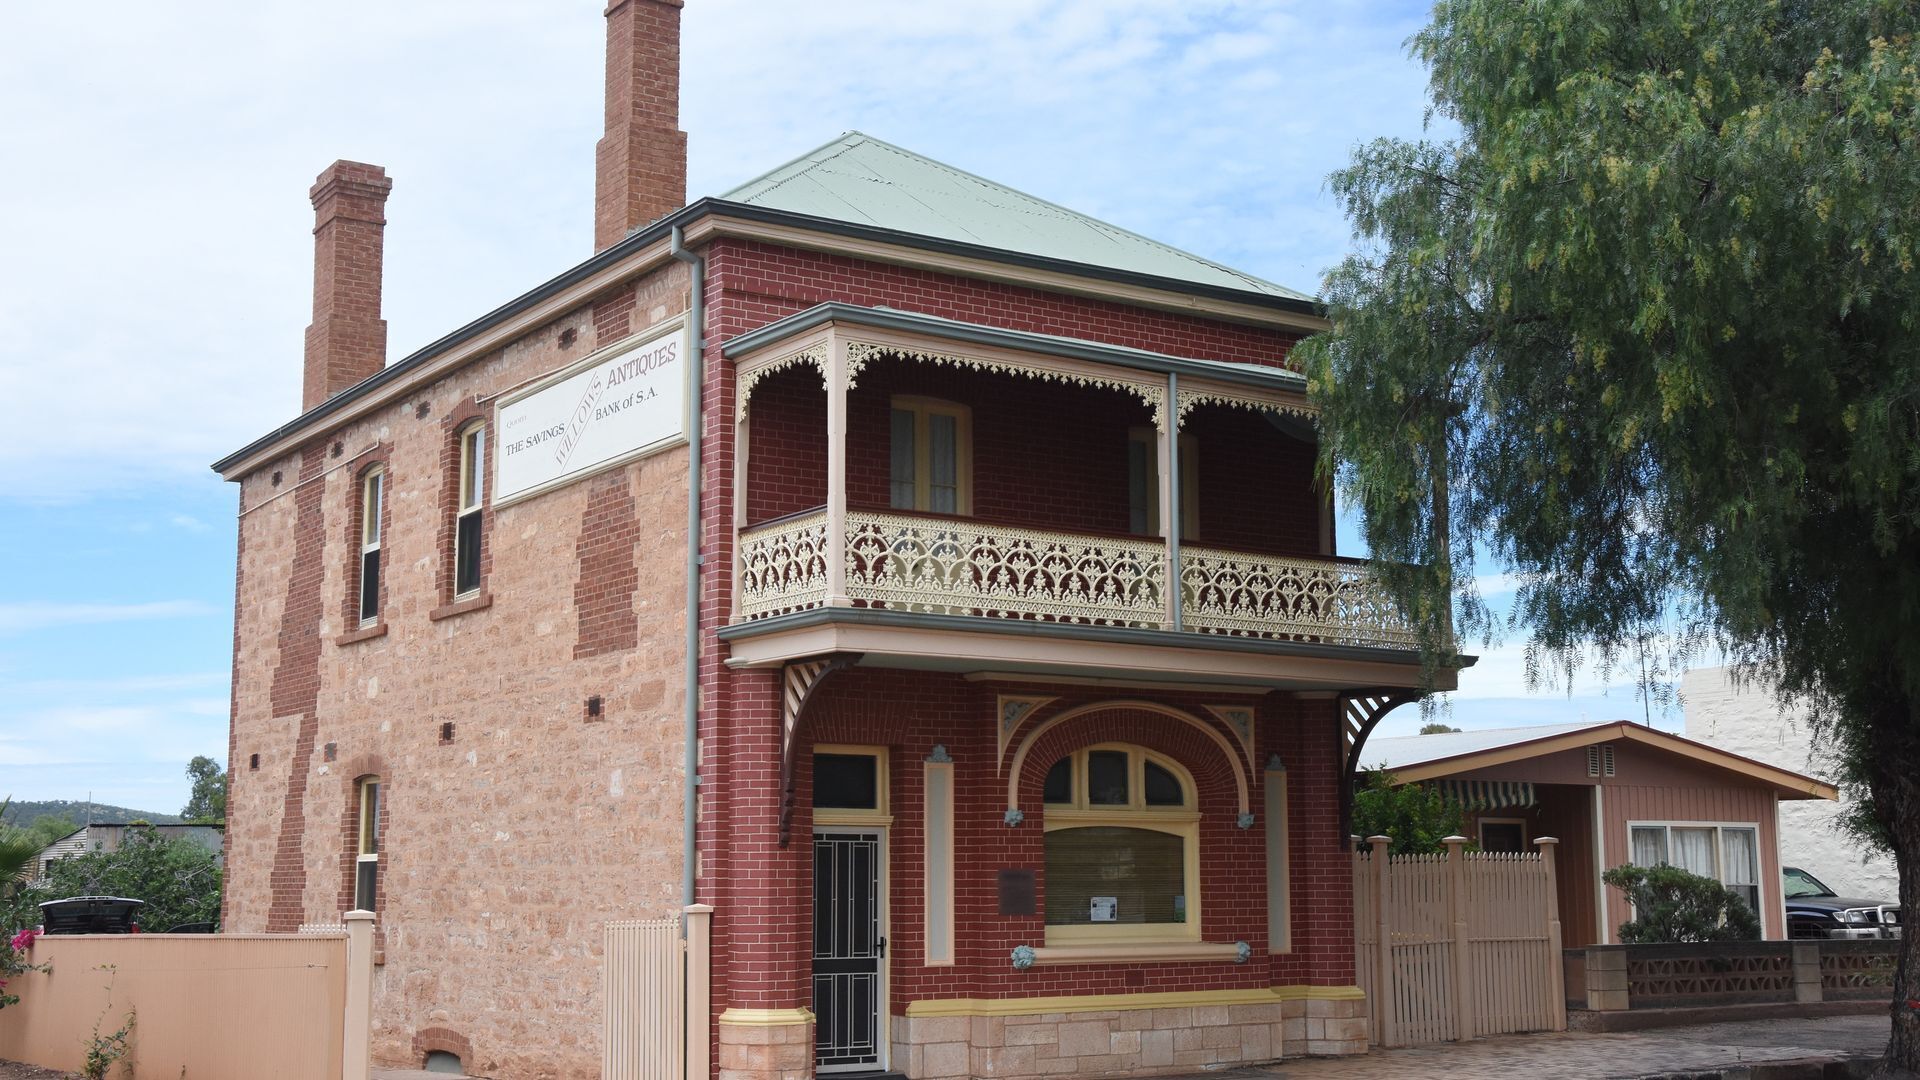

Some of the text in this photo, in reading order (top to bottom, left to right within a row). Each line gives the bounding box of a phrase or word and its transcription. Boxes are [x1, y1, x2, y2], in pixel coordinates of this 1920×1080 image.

[505, 386, 658, 456] THE SAVINGS BANK of S.A.
[555, 341, 677, 465] WILLOWS ANTIQUES
